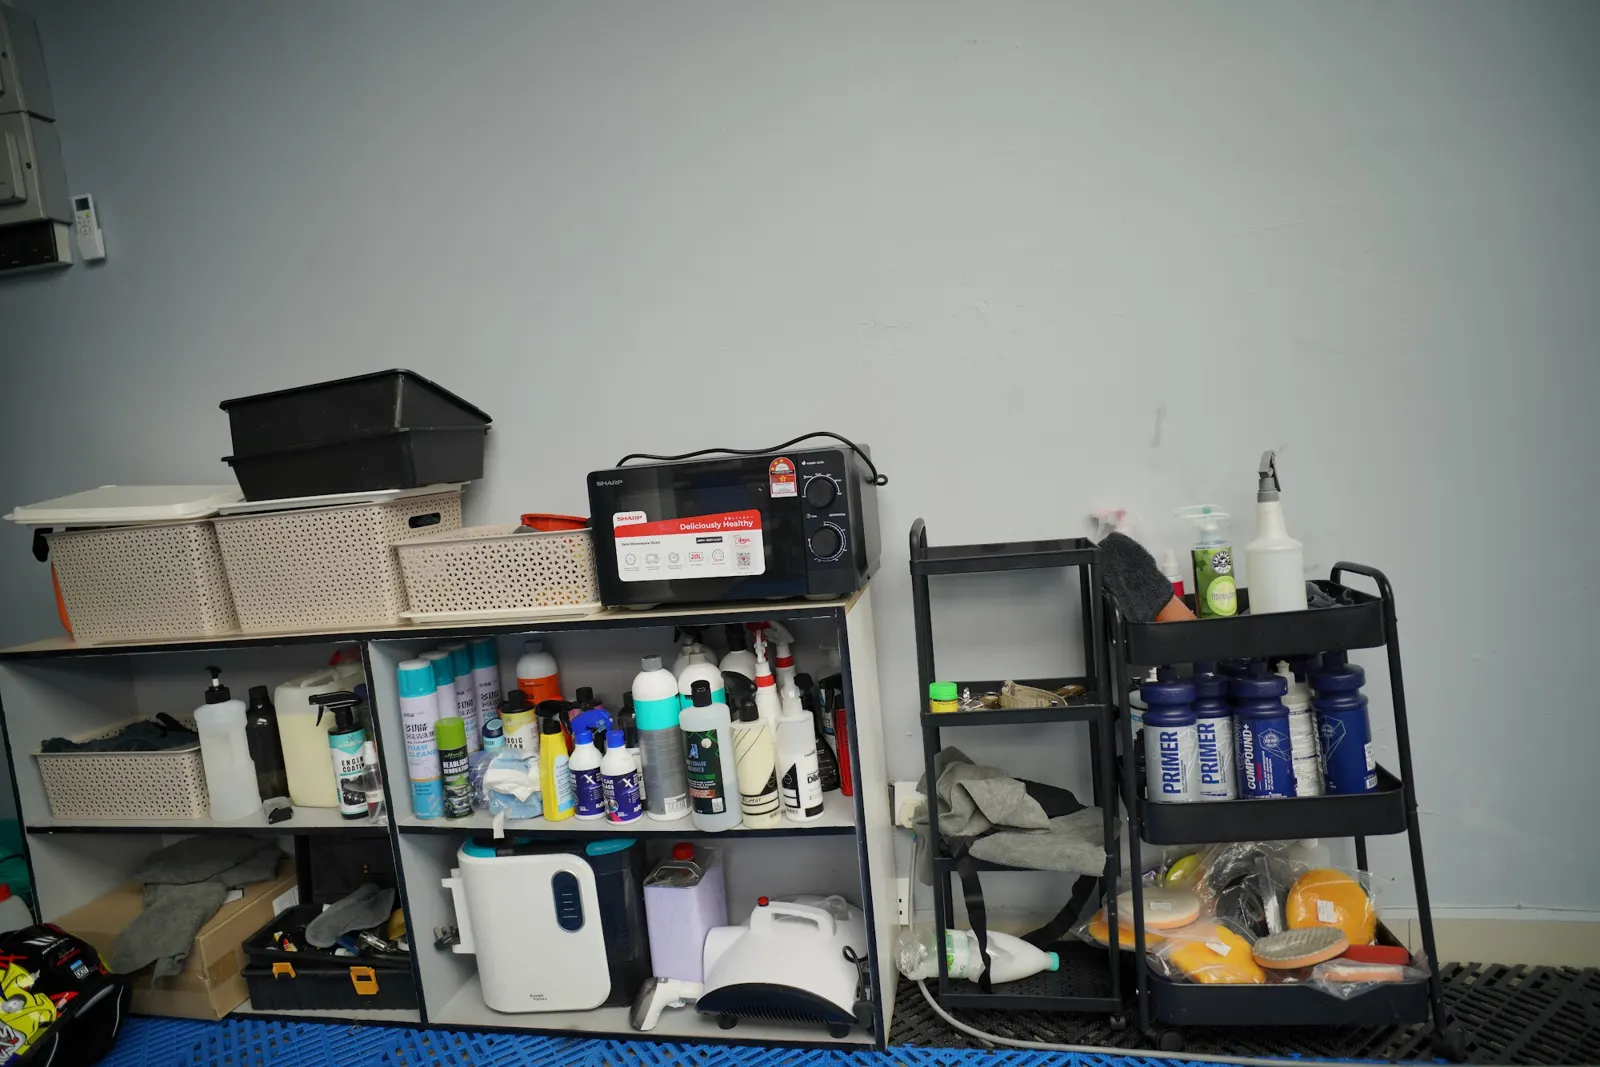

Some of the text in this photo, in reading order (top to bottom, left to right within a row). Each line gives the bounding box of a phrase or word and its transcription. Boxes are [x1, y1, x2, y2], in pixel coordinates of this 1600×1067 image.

[680, 520, 753, 530] Deliciously Healthy
[341, 756, 364, 767] ENGIN
[342, 762, 365, 773] COATIN
[1160, 731, 1181, 793] PRIMER
[1198, 723, 1219, 784] PRIMER
[1243, 723, 1256, 790] COMPOUND+
